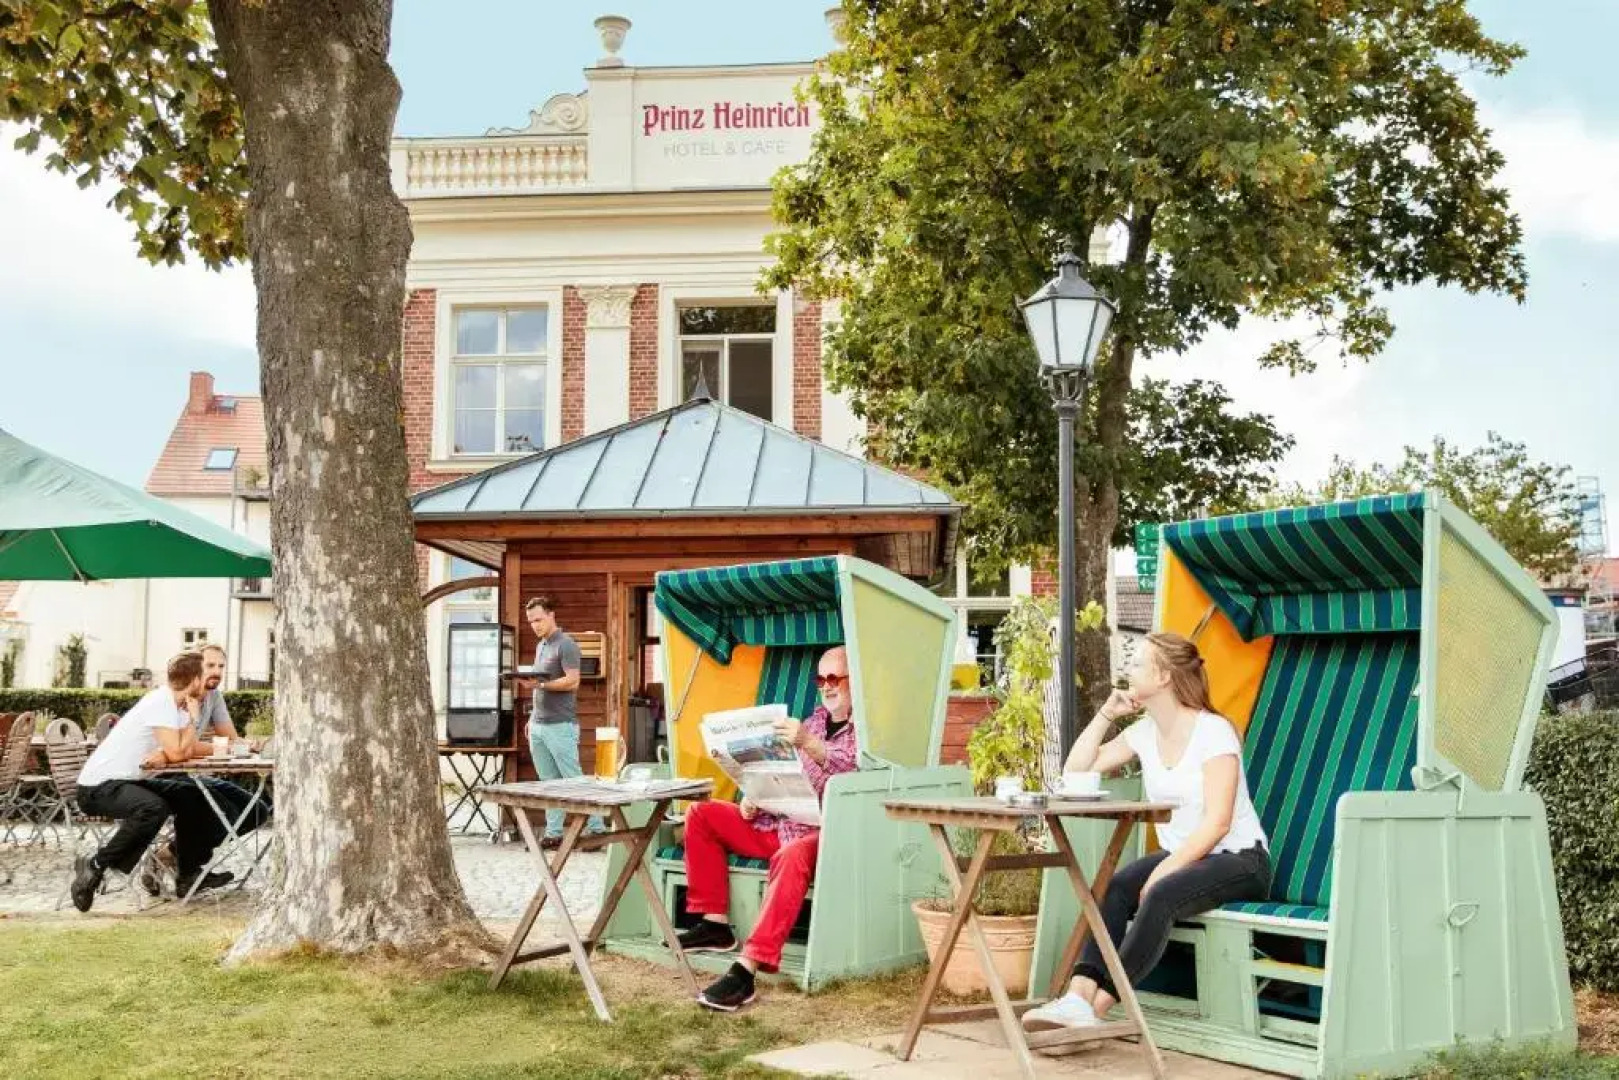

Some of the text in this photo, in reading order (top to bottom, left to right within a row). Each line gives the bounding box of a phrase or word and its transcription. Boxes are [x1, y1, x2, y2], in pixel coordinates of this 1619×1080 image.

[643, 102, 810, 136] Prinz Heinrich
[663, 141, 721, 157] HOTEL
[725, 141, 738, 155] &
